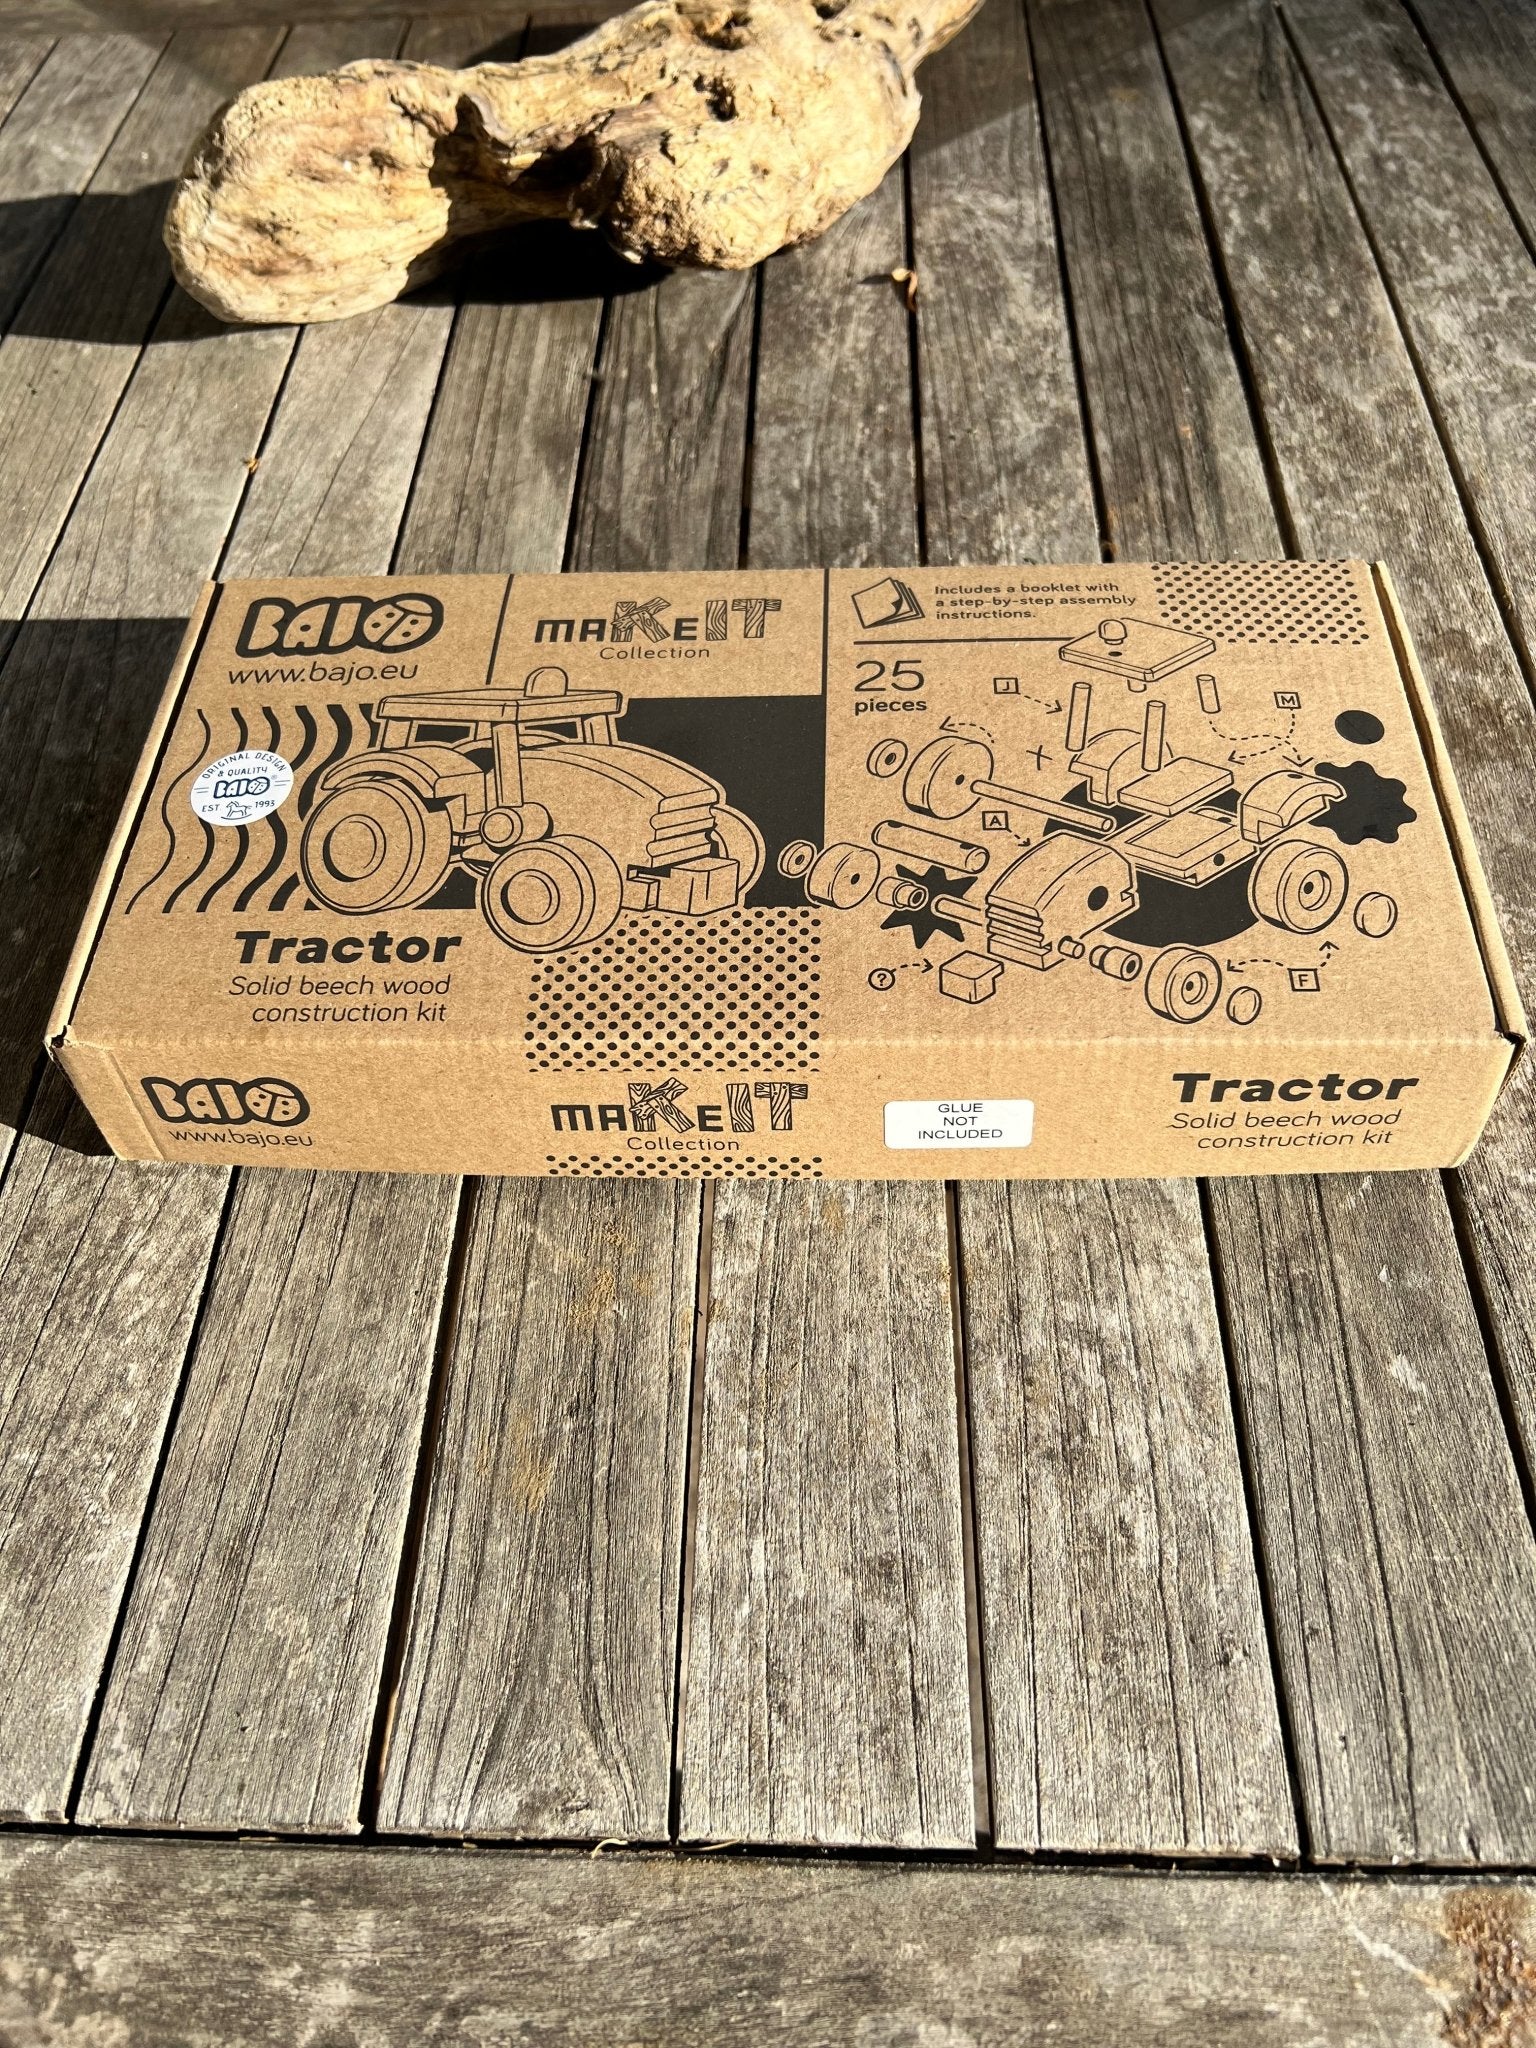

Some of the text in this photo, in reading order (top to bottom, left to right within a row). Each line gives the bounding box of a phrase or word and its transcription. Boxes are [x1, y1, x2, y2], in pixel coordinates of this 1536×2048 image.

[935, 585, 1001, 595] Includes
[1021, 583, 1080, 593] booklet
[1085, 583, 1119, 592] with
[950, 596, 1054, 609] step-by-step
[1059, 595, 1136, 606] assembly
[936, 609, 1036, 620] instructions.
[235, 593, 444, 658] BAJO
[600, 646, 710, 660] Collection
[228, 661, 418, 686] www.bajo.eu
[854, 660, 925, 692] 25
[854, 698, 928, 716] pieces
[202, 752, 287, 779] ORIGINAL DESIGN
[227, 766, 268, 777] QUALITY
[213, 776, 270, 799] BAJO
[255, 800, 275, 808] 1993
[235, 930, 462, 964] Tractor
[228, 973, 451, 996] Solid beech wood
[252, 1001, 447, 1023] construction kit
[1172, 1073, 1420, 1103] Tractor
[140, 1077, 311, 1127] BAJO
[938, 1102, 983, 1113] GLUE
[943, 1116, 978, 1126] NOT
[1168, 1109, 1402, 1129] Solid beech wood
[168, 1128, 313, 1148] www.bajo.eu
[627, 1136, 740, 1151] Collection
[918, 1129, 1003, 1140] INCLUDED
[1197, 1129, 1393, 1149] construction kit
